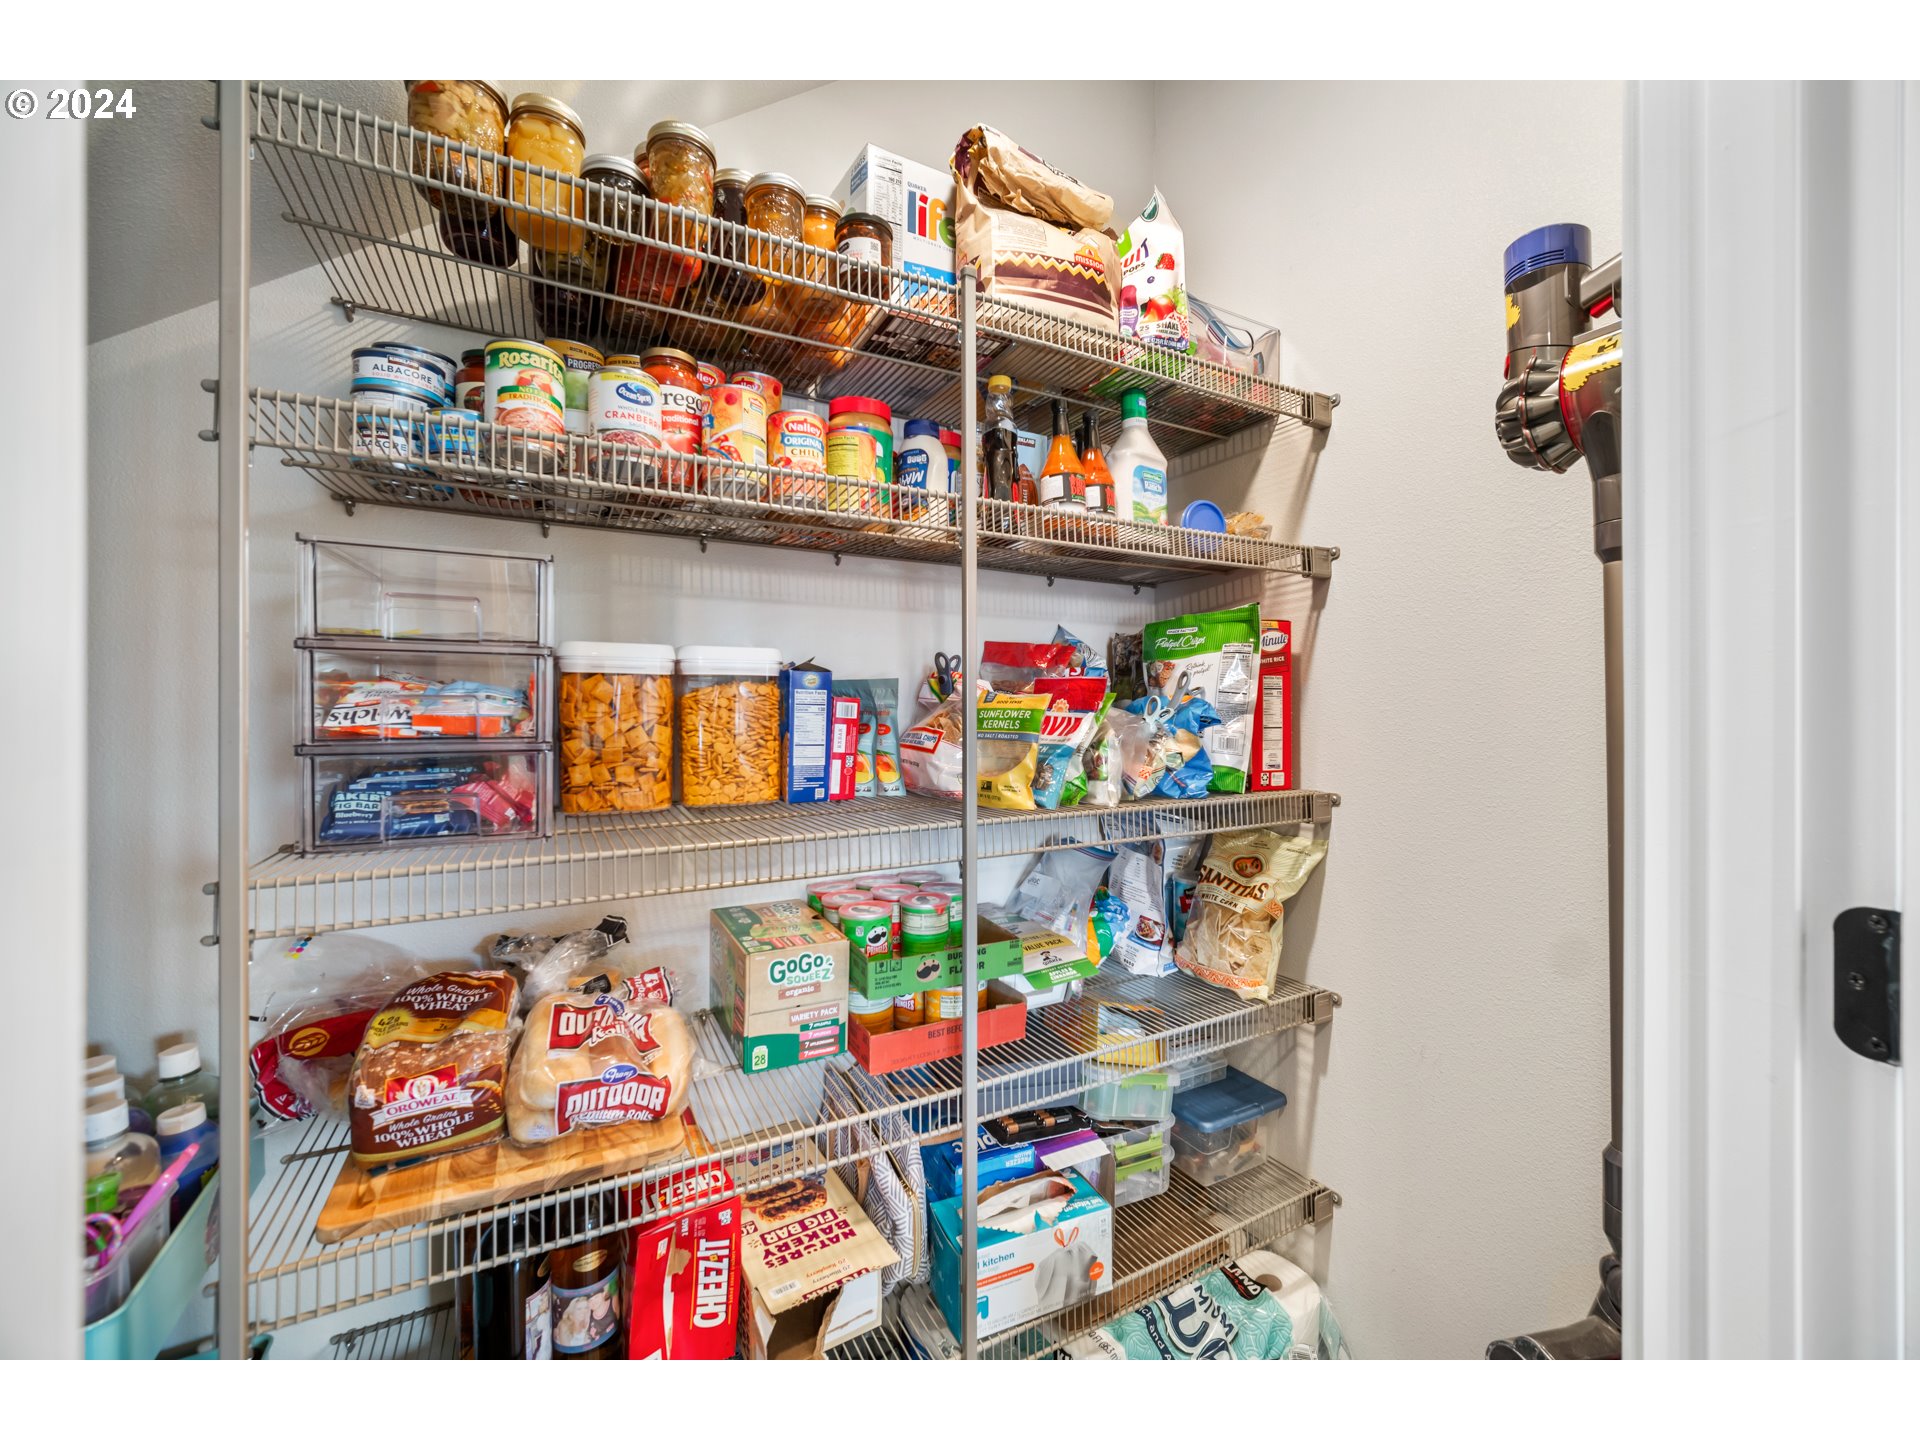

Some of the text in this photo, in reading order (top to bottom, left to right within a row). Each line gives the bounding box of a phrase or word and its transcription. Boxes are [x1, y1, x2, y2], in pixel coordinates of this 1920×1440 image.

[907, 190, 956, 249] life
[1120, 237, 1150, 268] UIT
[1123, 262, 1146, 276] POPS
[372, 363, 433, 385] ALBACORE
[661, 390, 703, 415] rego
[604, 410, 661, 429] CRANBERR
[788, 422, 821, 437] Nalley
[357, 439, 408, 452] LBACORE
[783, 435, 822, 450] ORIGINAL
[791, 448, 820, 458] CHILI
[979, 710, 1032, 719] SUNFLOWER
[982, 719, 1021, 729] KERNELS
[335, 791, 387, 802] AKERY
[356, 802, 380, 810] BAR
[335, 812, 374, 820] Blueberry
[1197, 864, 1270, 903] SANTITAS
[1200, 893, 1239, 909] WHITE CORN
[866, 943, 888, 957] PRINGLES
[1022, 938, 1064, 951] VALUE PACK
[769, 953, 824, 984] GoGo
[406, 983, 487, 995] Whole Grains
[785, 984, 815, 997] organic
[394, 992, 494, 1003] 100% WHOLE
[413, 1001, 472, 1011] WHEAT
[790, 1006, 838, 1022] VARIETY PACK
[808, 1022, 814, 1030] 7
[927, 1029, 945, 1039] BEST
[804, 1041, 810, 1049] 7
[754, 1054, 766, 1066] 28
[803, 1050, 809, 1058] 7
[386, 1092, 459, 1116] OROWEAT
[565, 1081, 666, 1119] OUTDOOR
[388, 1109, 459, 1132] Whole Grains
[626, 1109, 655, 1121] Rolls
[374, 1111, 475, 1144] 100% WHOLE
[396, 1127, 455, 1148] WHEAT
[1005, 1156, 1032, 1168] FREEZER
[681, 1217, 689, 1232] BAGS
[764, 1210, 836, 1245] FIG BAR
[762, 1218, 851, 1261] BAKERY
[982, 1251, 1015, 1268] kitchen
[806, 1263, 837, 1278] Raspberry
[812, 1268, 842, 1284] Blueberry
[1092, 1334, 1104, 1344] FT
[1149, 1324, 1166, 1350] and
